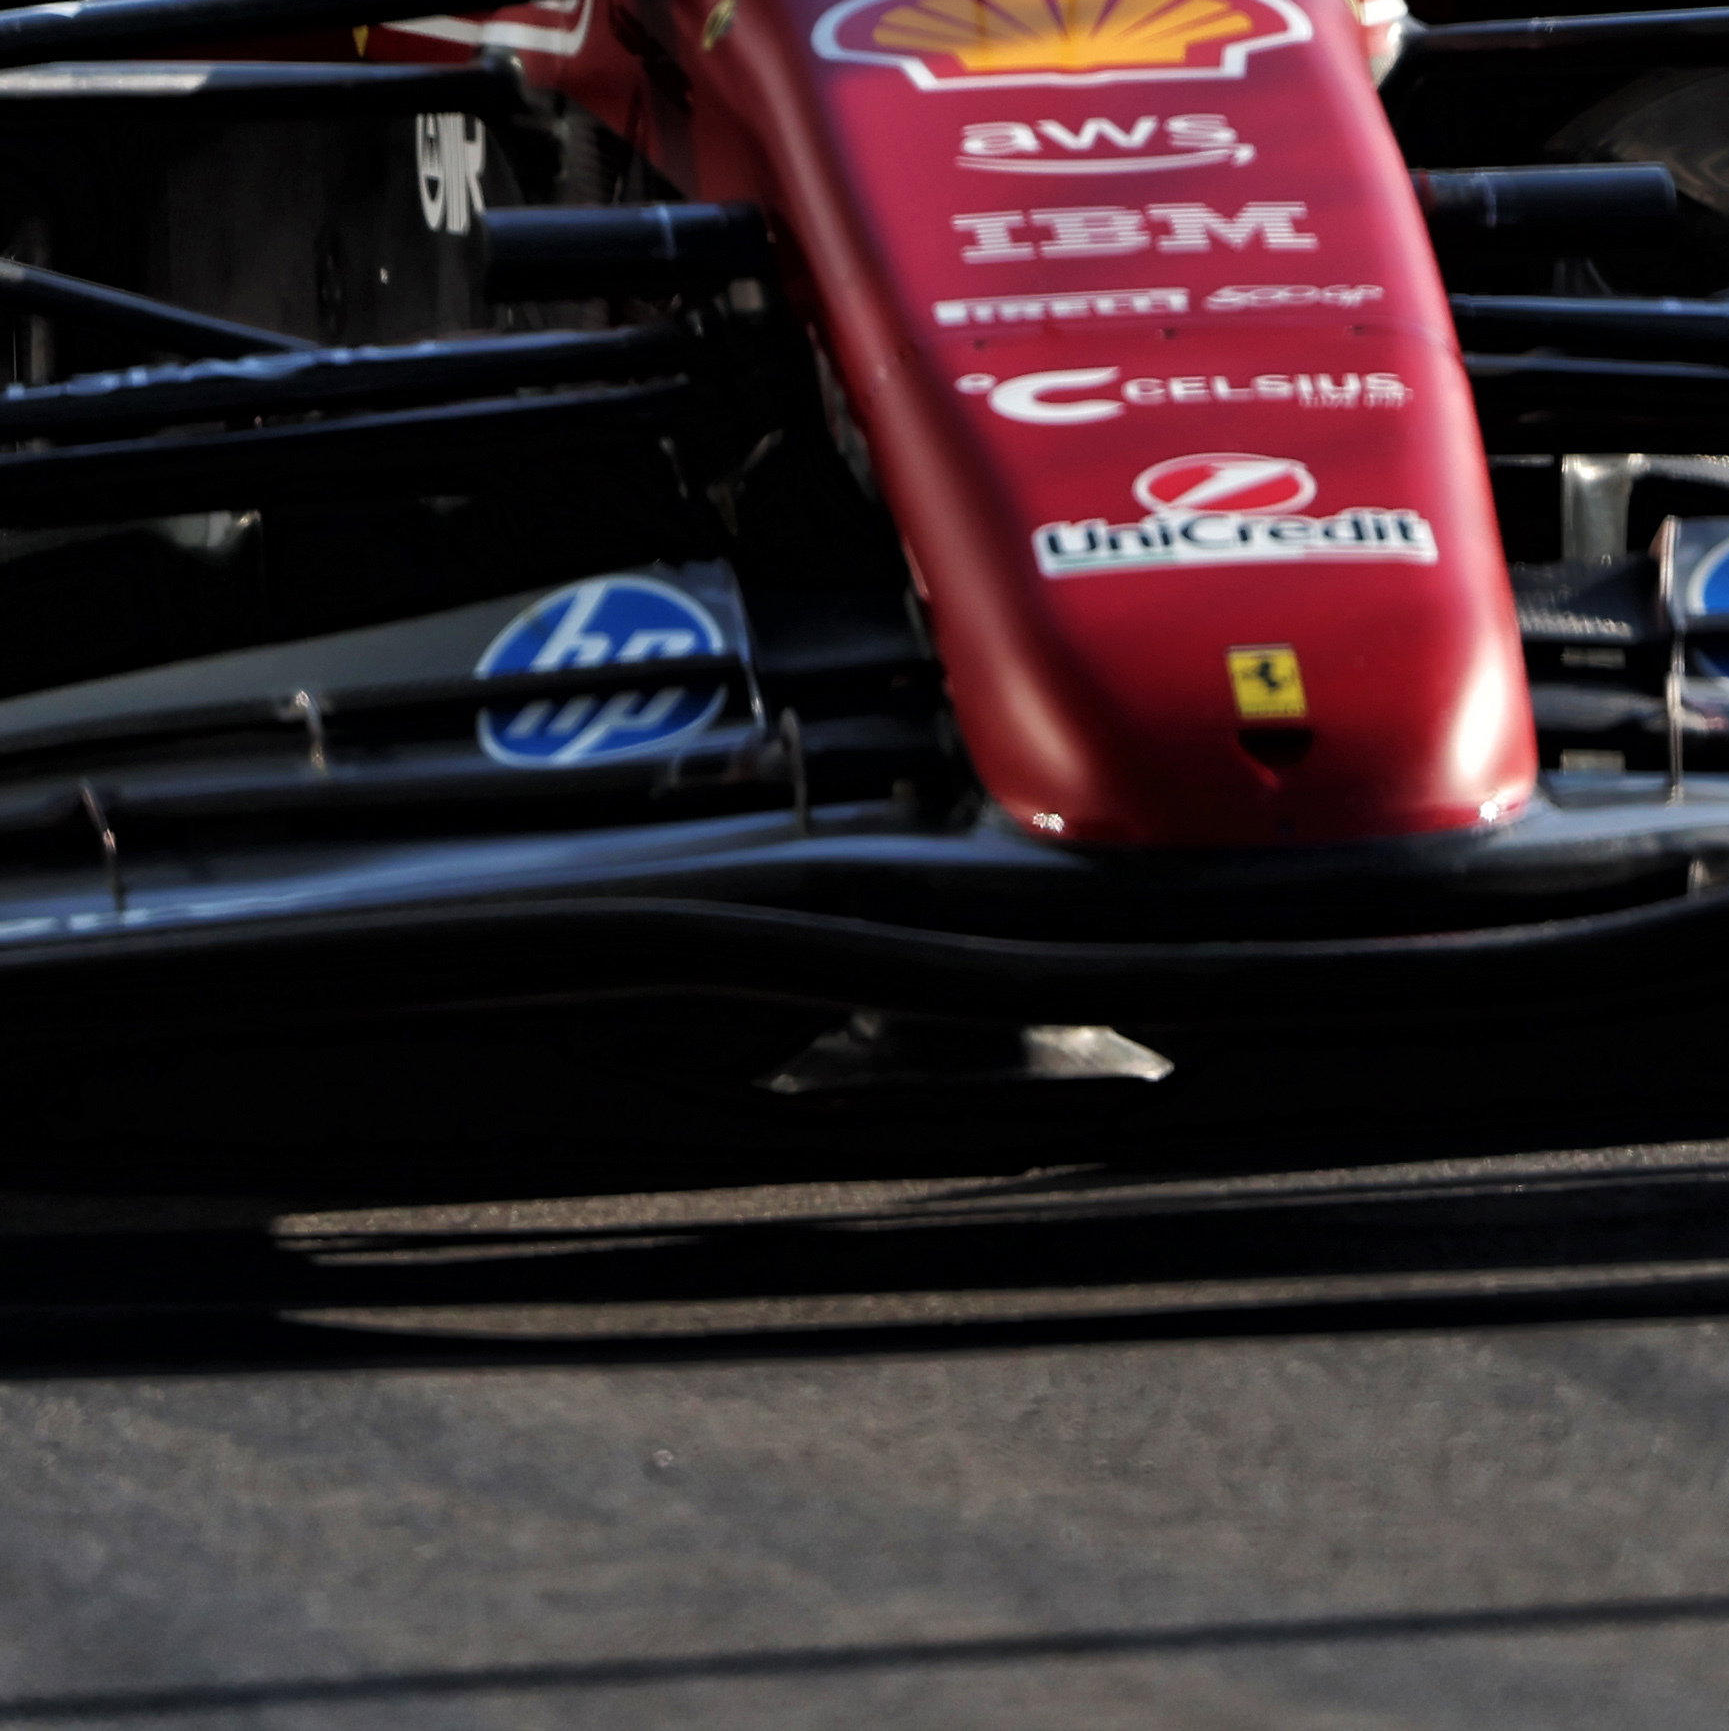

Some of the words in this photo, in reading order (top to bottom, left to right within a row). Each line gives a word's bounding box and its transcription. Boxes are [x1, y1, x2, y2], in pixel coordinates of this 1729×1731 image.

[960, 114, 1240, 160] aws
[952, 200, 1319, 264] IBM
[1120, 371, 1406, 404] CELSIUS
[1043, 511, 1422, 559] UniCredit
